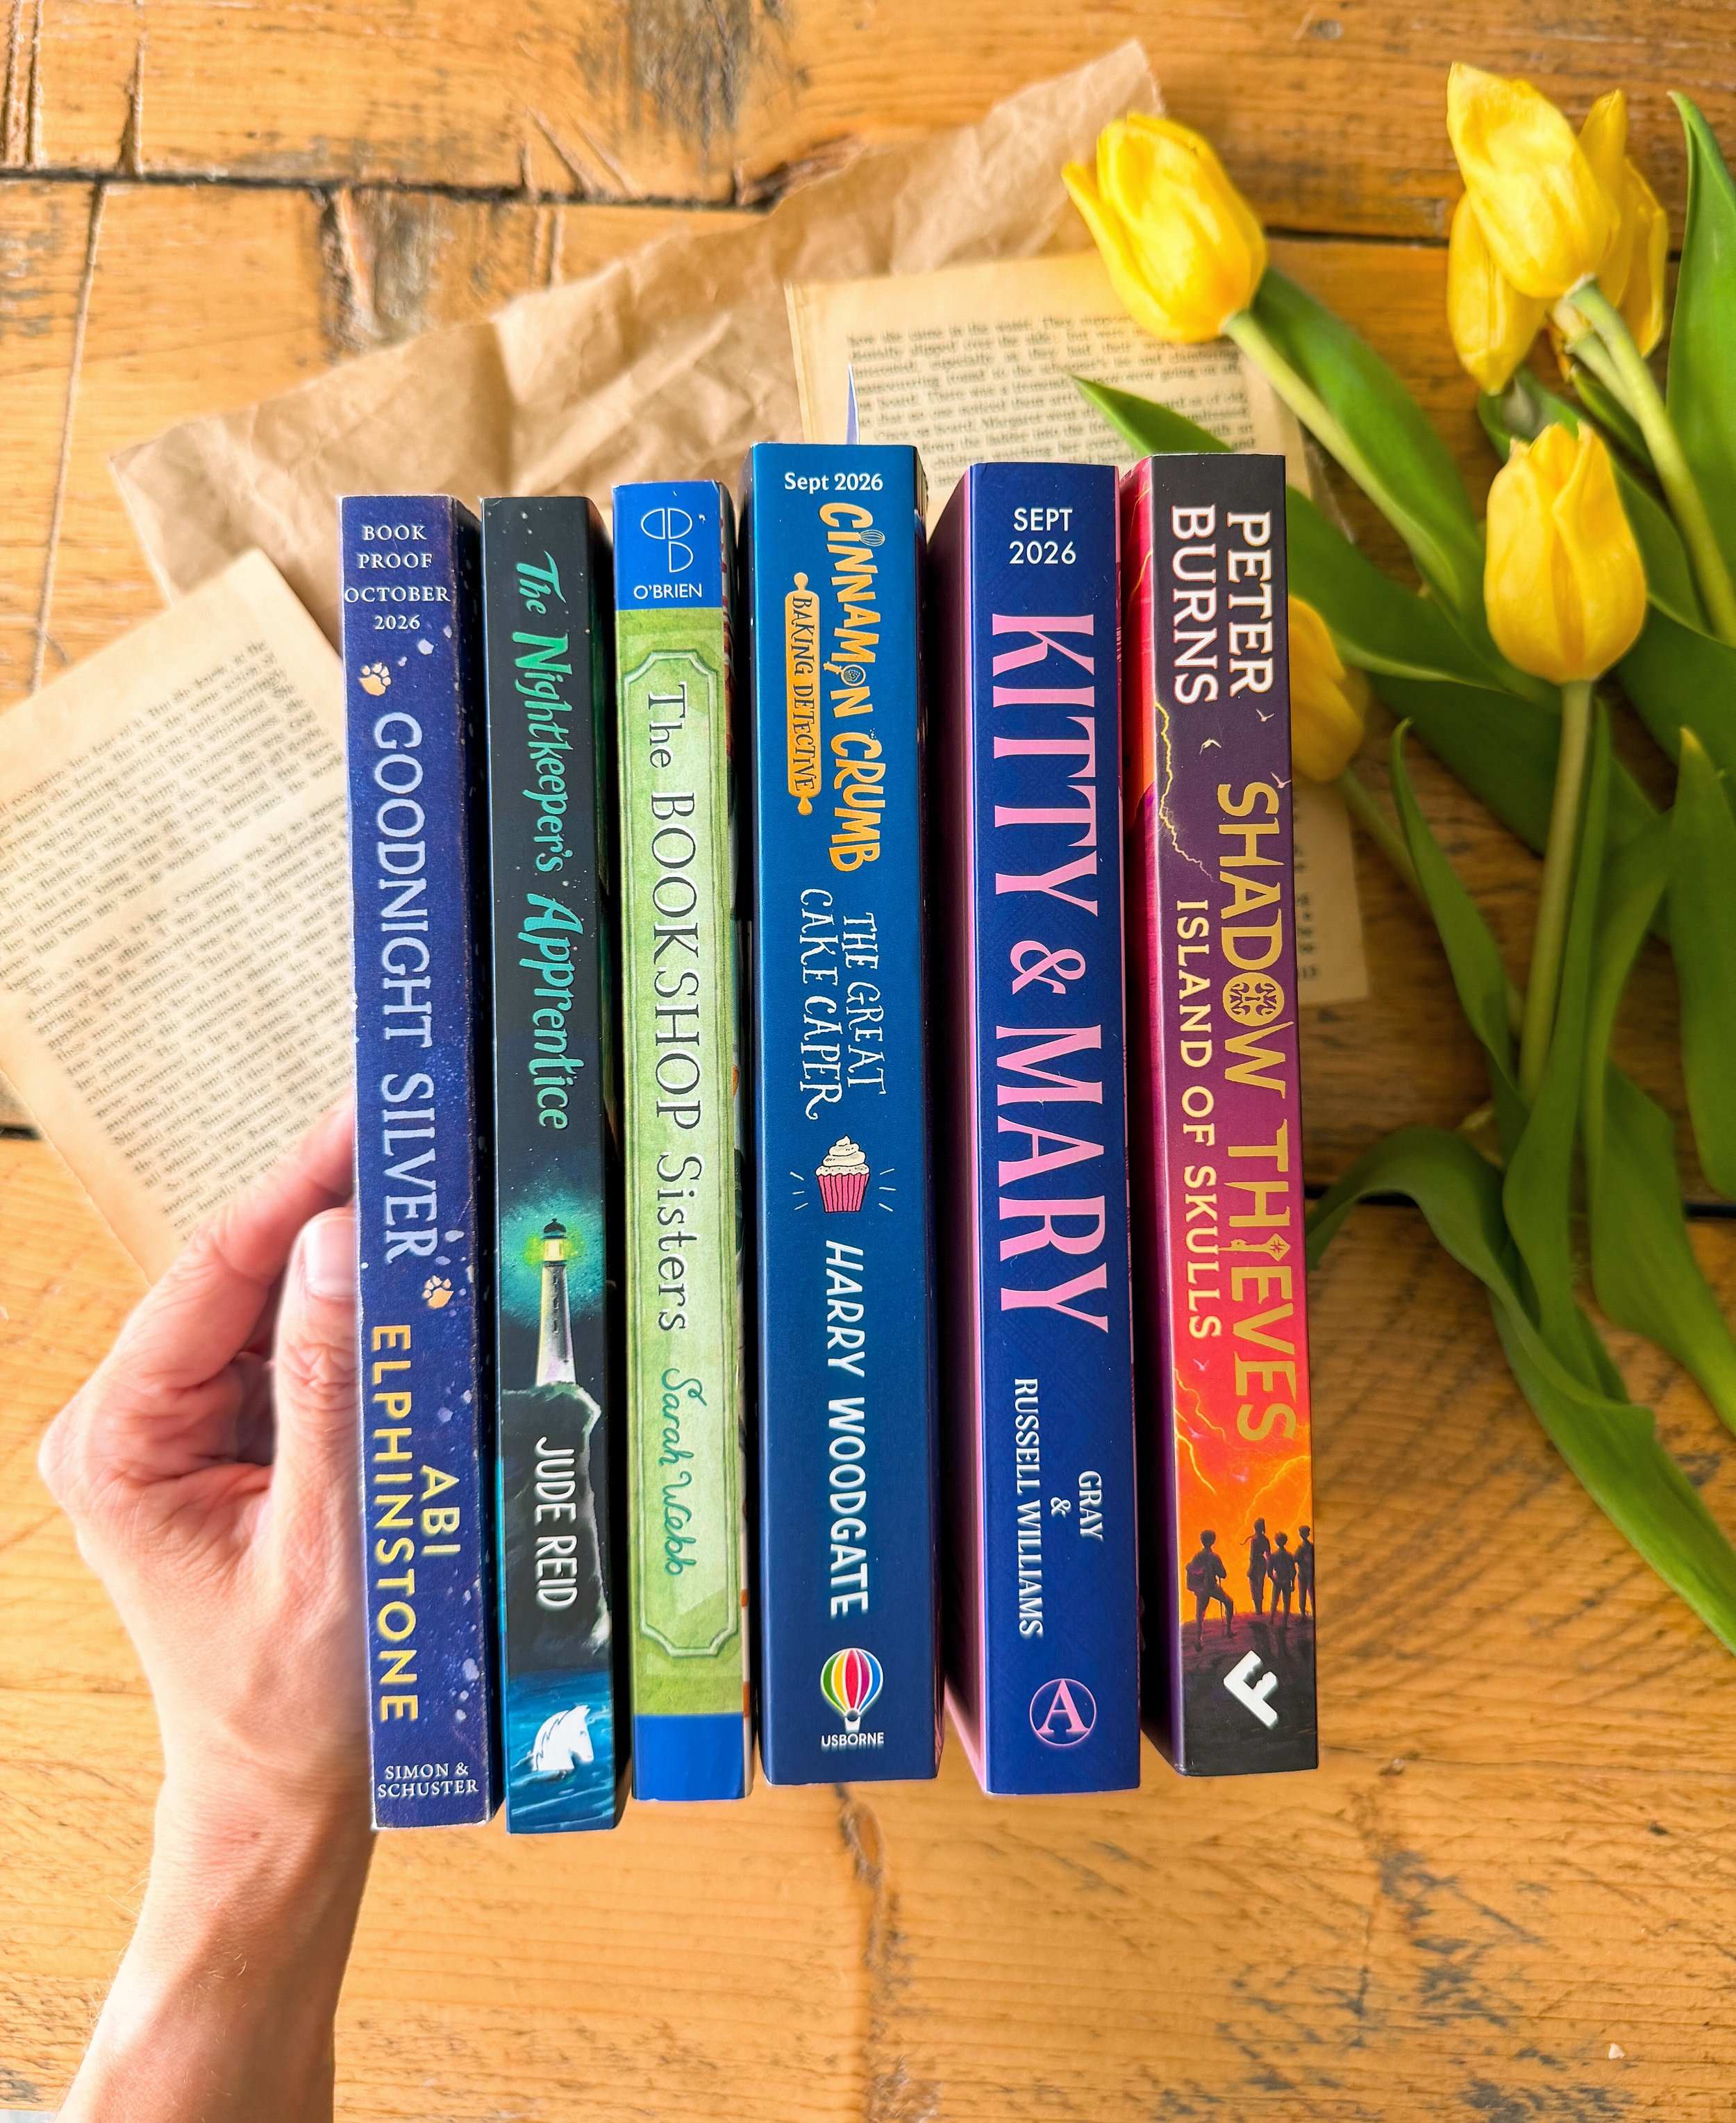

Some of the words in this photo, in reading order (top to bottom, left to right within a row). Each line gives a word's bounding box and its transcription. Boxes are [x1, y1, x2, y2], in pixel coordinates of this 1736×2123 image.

[363, 526, 426, 540] BOOK
[784, 472, 829, 494] Sept
[834, 474, 883, 491] 2026
[1013, 508, 1073, 532] SEPT
[345, 587, 451, 603] OCTOBER
[359, 553, 433, 569] PROOF
[516, 551, 565, 615] The
[633, 583, 703, 600] O'BRIEN
[1009, 542, 1076, 565] 2026
[1171, 505, 1219, 705] BURNS
[1227, 512, 1274, 698] PETER
[374, 615, 421, 631] 2026
[790, 597, 816, 676] BAKING
[819, 503, 885, 718] CINNAMON
[511, 631, 574, 872] Nightkeeper's
[648, 684, 687, 769] The
[792, 683, 817, 791] DETECTIVE
[992, 613, 1098, 916] KITTY
[828, 732, 885, 872] CRUMB
[374, 713, 433, 1048] GOODNIGHT
[651, 792, 701, 1131] BOOKSHOP
[799, 888, 838, 986] CAKE
[842, 912, 878, 970] THE
[1010, 940, 1086, 994] &
[1176, 901, 1213, 1067] ISLAND
[1217, 782, 1293, 1099] SHADOW
[518, 893, 584, 1130] Apprentice
[799, 995, 843, 1121] CAPER
[846, 981, 886, 1095] GREAT
[381, 1072, 438, 1264] SILVER
[1180, 1086, 1216, 1147] OF
[996, 1024, 1108, 1333] MARY
[656, 1155, 703, 1331] Sisters
[1183, 1165, 1222, 1338] SKULLS
[1217, 1119, 1297, 1441] THIEVES
[825, 1240, 865, 1379] HARRY
[661, 1368, 708, 1467] Sarah
[1014, 1378, 1041, 1495] RUSSELL
[372, 1325, 418, 1722] ELPHINSTONE
[422, 1465, 460, 1556] ABI
[535, 1436, 576, 1524] JUDE
[662, 1470, 697, 1576] Webb
[828, 1397, 869, 1617] WOODGATE
[1050, 1497, 1071, 1517] &
[1078, 1470, 1103, 1541] GRAY
[535, 1535, 578, 1610] REID
[1017, 1501, 1044, 1639] WILLIAMS
[378, 1780, 478, 1798] SCHUSTER
[385, 1763, 448, 1779] SIMON
[456, 1762, 469, 1774] &
[821, 1732, 884, 1747] USBORNE
